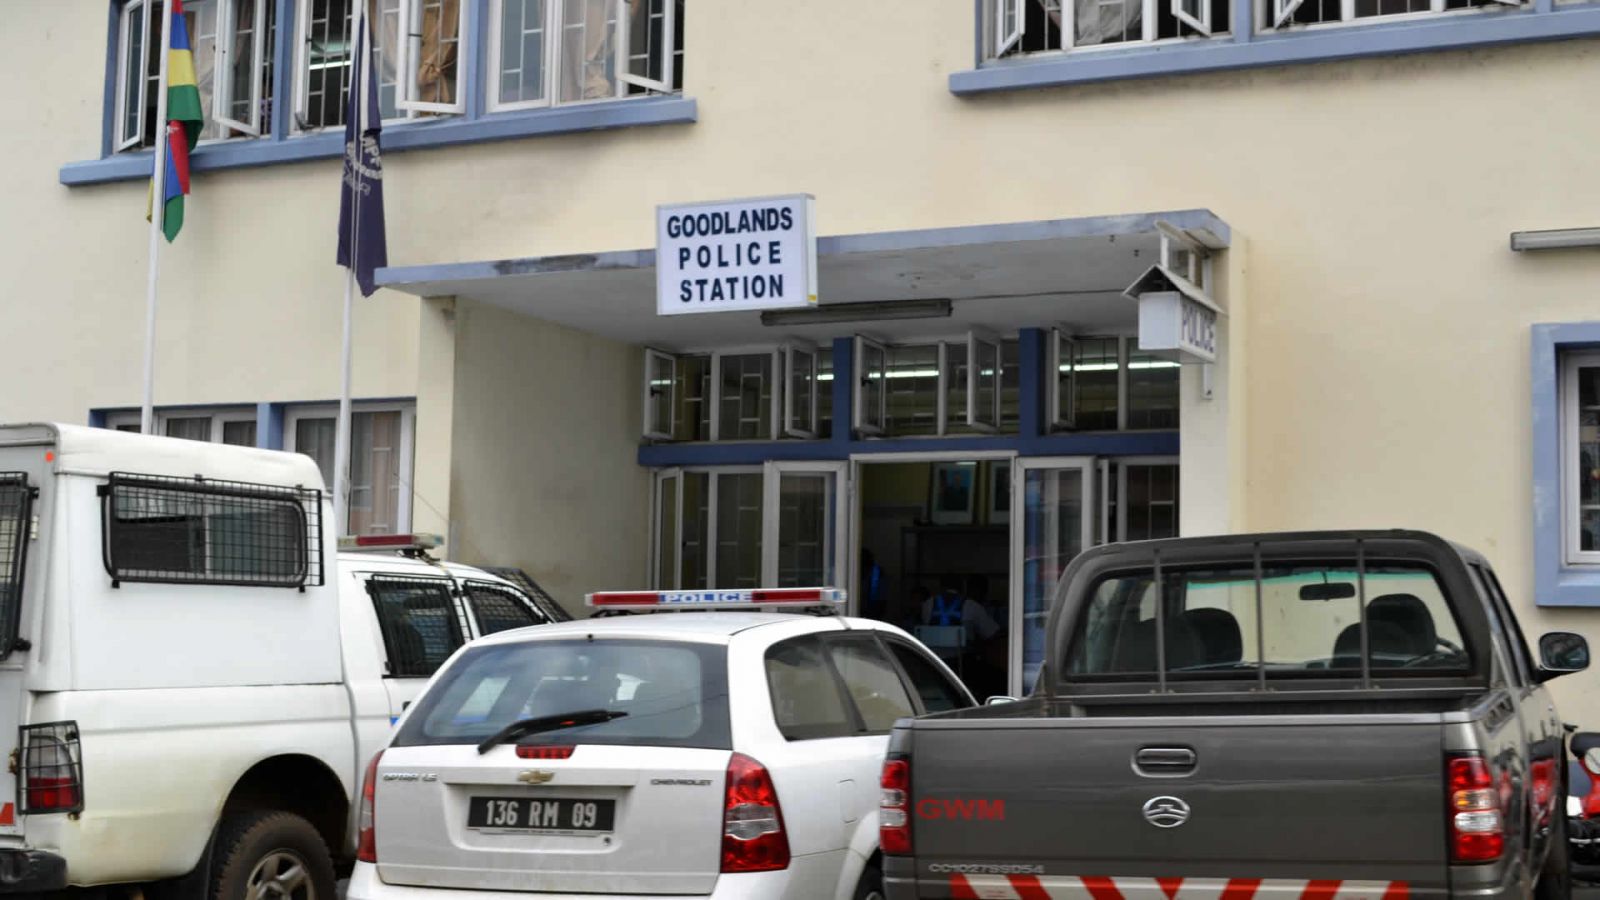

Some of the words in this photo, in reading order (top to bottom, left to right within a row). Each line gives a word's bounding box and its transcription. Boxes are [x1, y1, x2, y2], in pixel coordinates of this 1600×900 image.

[667, 206, 793, 238] GOODLANDS
[679, 241, 781, 270] POLICE
[680, 274, 783, 302] STATION
[1182, 304, 1214, 353] POLICE
[664, 593, 752, 603] POLICE
[486, 800, 519, 825] 136
[528, 801, 560, 827] RM
[571, 802, 597, 828] 09
[915, 796, 1006, 821] GWM
